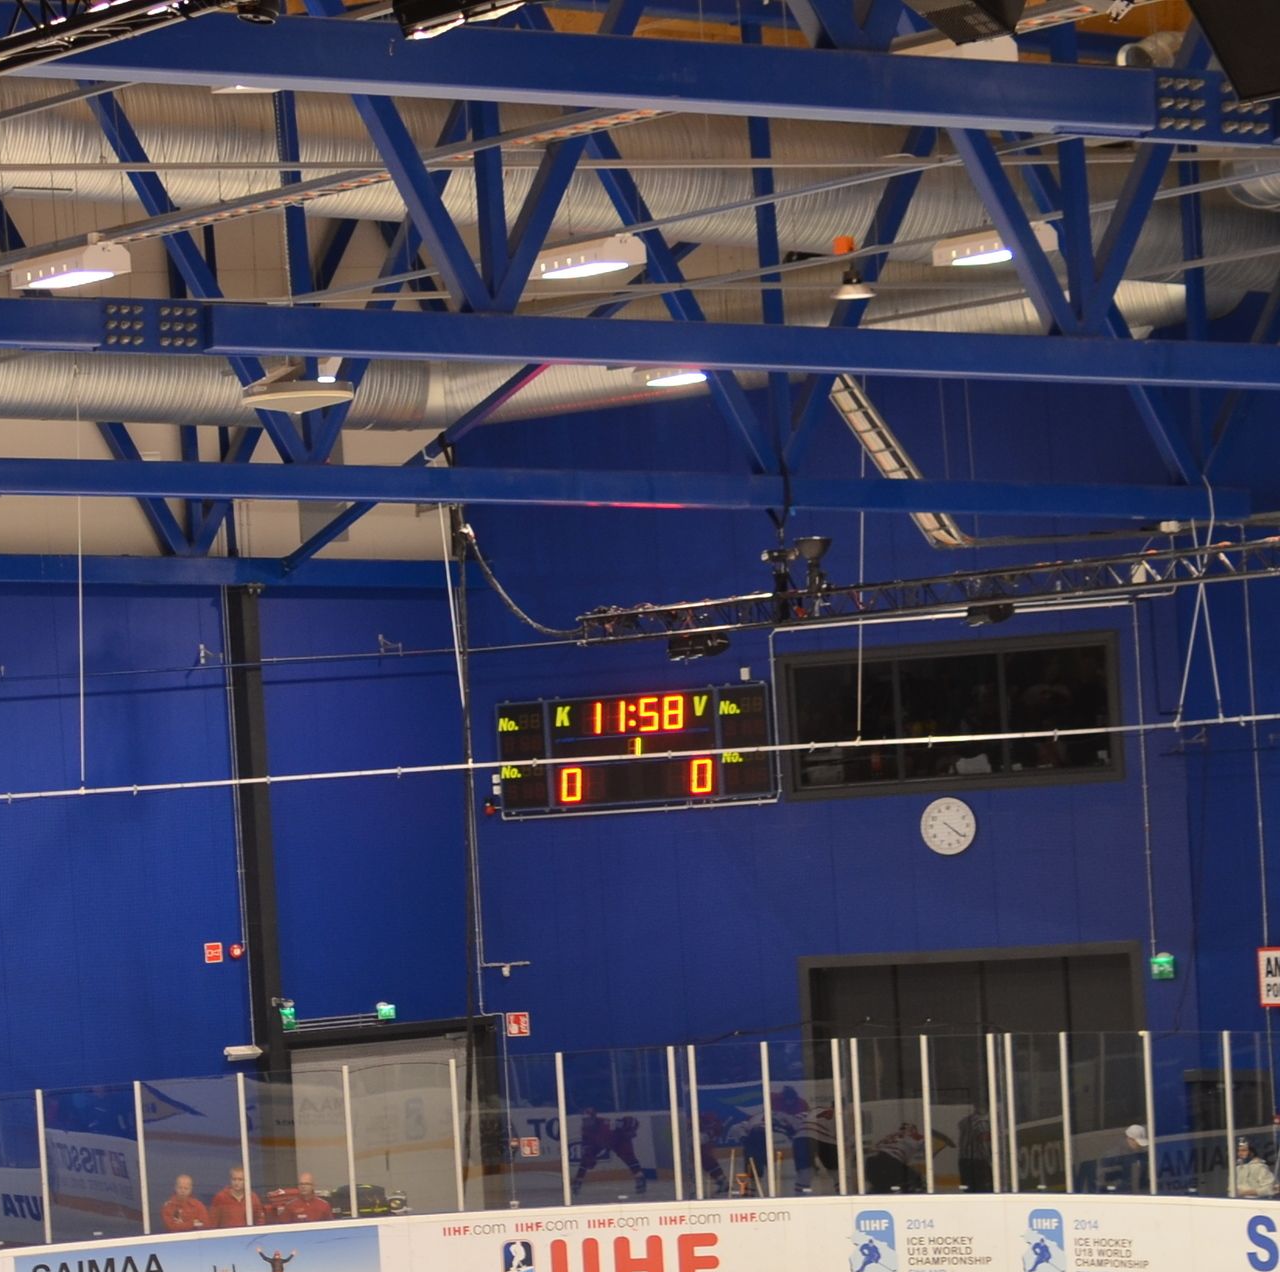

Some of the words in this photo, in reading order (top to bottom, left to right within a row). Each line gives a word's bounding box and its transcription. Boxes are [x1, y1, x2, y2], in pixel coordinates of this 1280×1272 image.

[693, 695, 708, 717] V
[718, 700, 741, 715] No.
[555, 705, 571, 728] K
[593, 694, 684, 735] 11:58
[498, 717, 519, 732] No.
[501, 764, 522, 779] No.
[690, 758, 713, 793] 0
[560, 767, 583, 802] 0
[588, 1214, 650, 1229] IIHF.com
[659, 1211, 721, 1226] IIHF.com
[730, 1209, 791, 1223] IIHF.com
[443, 1221, 507, 1237] IIHF.com
[515, 1217, 579, 1233] IIHF.com
[860, 1219, 890, 1231] IIHF
[906, 1218, 935, 1230] 2014
[1033, 1218, 1059, 1230] IIHF
[1073, 1219, 1099, 1231] 2014
[906, 1237, 926, 1246] ICE
[928, 1236, 973, 1246] HOCKEY
[1074, 1238, 1091, 1247] ICE
[1093, 1238, 1132, 1248] HOCKEY
[907, 1247, 928, 1256] U18
[931, 1246, 972, 1256] WORLD
[1075, 1248, 1093, 1257] U18
[1096, 1248, 1132, 1258] WORLD
[908, 1256, 992, 1266] CHAMPIONSHIP
[1075, 1258, 1150, 1269] CHAMPIONSHIP
